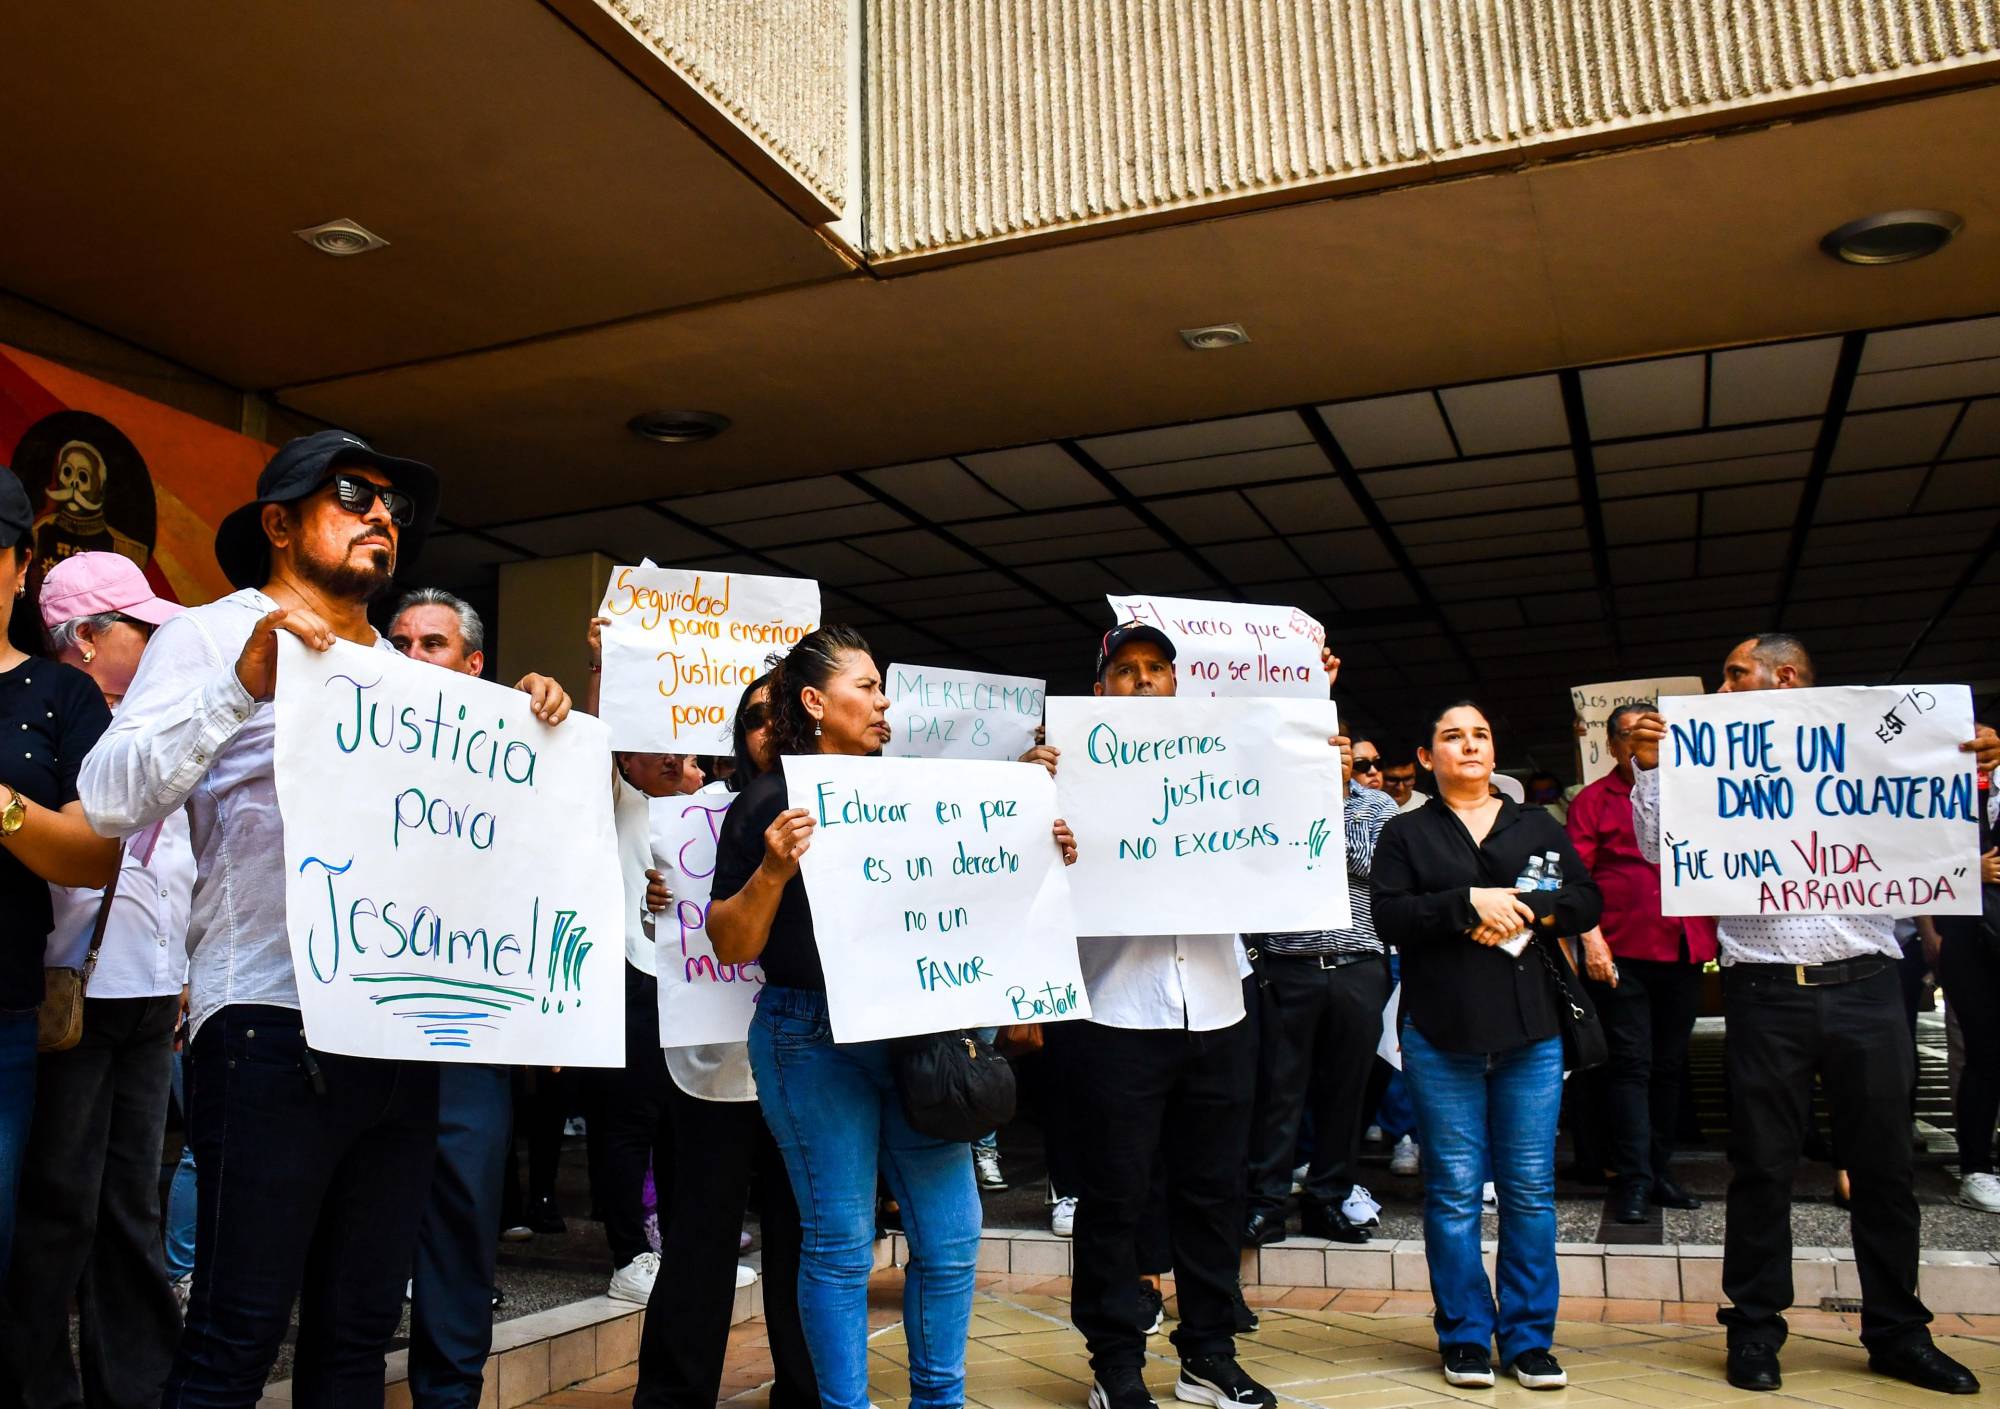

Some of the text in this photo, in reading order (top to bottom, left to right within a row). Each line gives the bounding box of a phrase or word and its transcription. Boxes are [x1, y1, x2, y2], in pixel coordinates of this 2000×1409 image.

[608, 568, 730, 630] Seguridad
[668, 617, 813, 645] para enseñar
[1245, 622, 1287, 651] que
[657, 647, 757, 696] Justicia
[1191, 661, 1220, 680] no
[1228, 661, 1250, 681] se
[1258, 654, 1310, 683] llena
[896, 671, 1045, 717] MERECEMOS
[1900, 688, 1937, 714] 75
[325, 674, 537, 786] Justicia
[671, 704, 725, 740] para
[908, 714, 990, 746] PAZ &
[1088, 722, 1227, 768] Queremos
[1671, 719, 1846, 773] NO FUE UN
[394, 788, 497, 851] para
[817, 781, 1018, 832] Educar en paz
[1152, 770, 1260, 825] justicia
[1717, 773, 1979, 823] DAÑO COLATERAL
[863, 841, 1019, 883] es un derecho
[1119, 837, 1157, 860] NO
[1724, 849, 1783, 880] UNA
[1791, 831, 1882, 877] VIDA
[904, 907, 968, 932] no un
[916, 956, 993, 991] FAVOR
